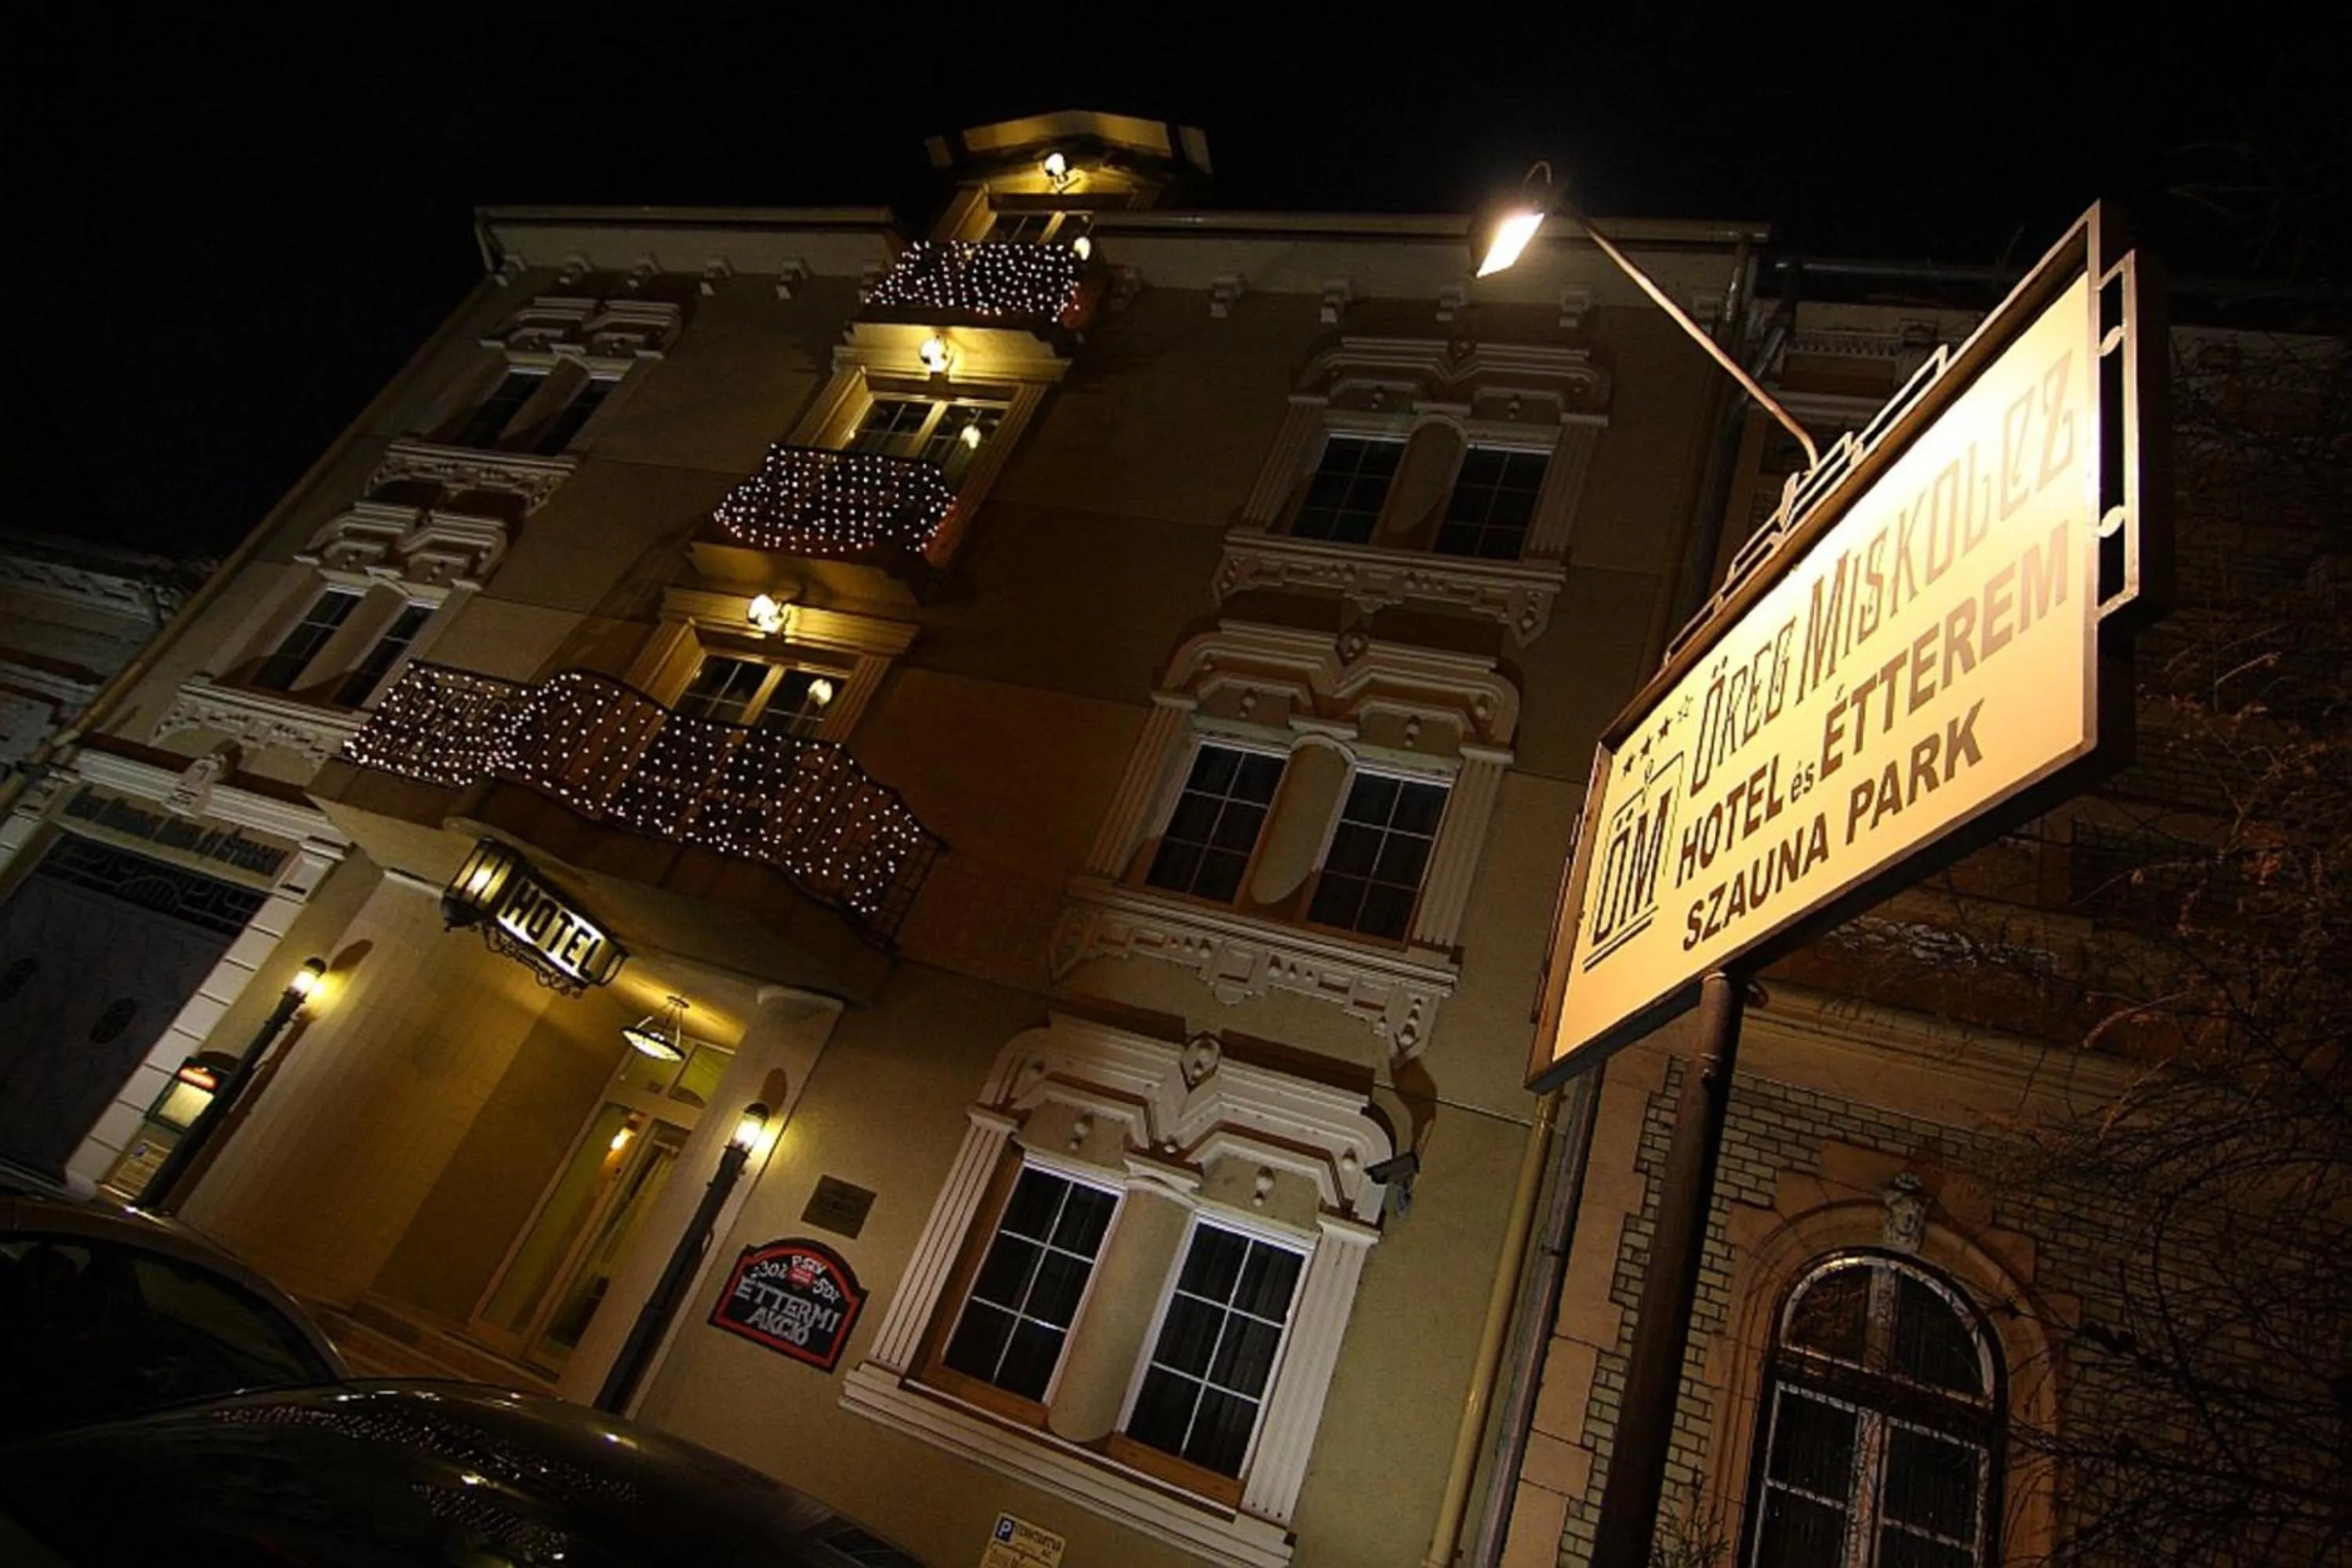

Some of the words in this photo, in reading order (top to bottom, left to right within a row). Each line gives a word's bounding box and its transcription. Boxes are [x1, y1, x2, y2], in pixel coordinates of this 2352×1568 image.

[1675, 753, 1784, 889] HOTEL
[1791, 760, 1814, 804] és
[1819, 519, 2069, 782] ÉTTEREM
[1690, 615, 1796, 798] ÖREG
[1795, 350, 2073, 708] MISKOLCZ
[503, 878, 601, 979] HOTEL
[1683, 812, 1829, 951] SZAUNA
[1846, 697, 1985, 846] PARK
